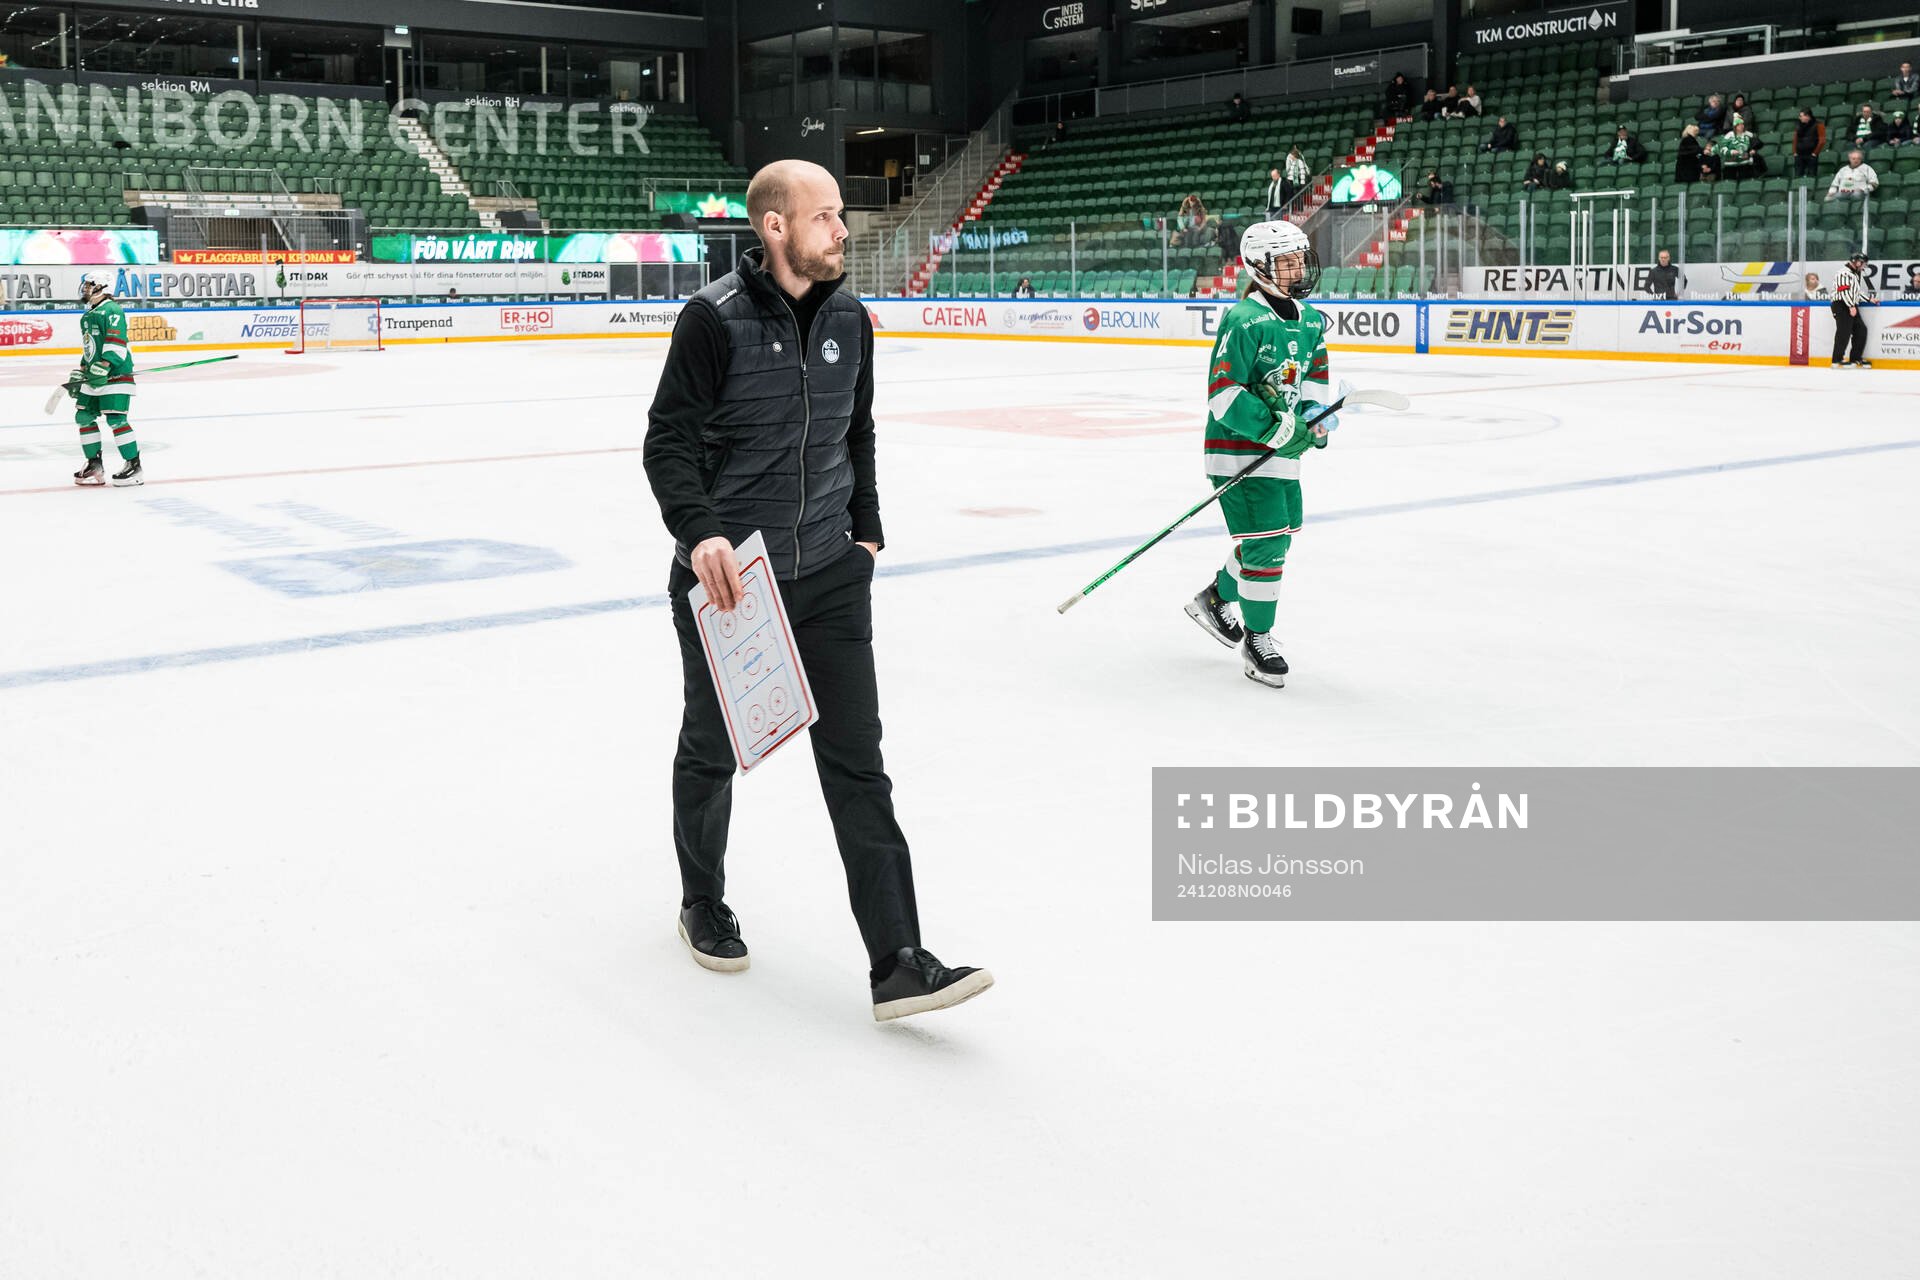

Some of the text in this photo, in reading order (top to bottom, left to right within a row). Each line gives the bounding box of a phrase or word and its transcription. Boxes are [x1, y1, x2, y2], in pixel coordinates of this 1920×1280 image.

[1061, 3, 1084, 16] INTER
[1054, 14, 1084, 28] SYSTEM
[1475, 28, 1502, 44] TKM
[141, 78, 210, 93] sektion RM
[464, 96, 520, 108] sektion RH
[608, 104, 655, 114] sektion M
[388, 98, 650, 156] CENTER
[414, 234, 537, 259] FÖR VÅRT RBK
[378, 272, 407, 281] schysst
[131, 317, 163, 329] EURO
[253, 313, 295, 327] Tommy
[385, 316, 453, 331] Tranpenad
[504, 311, 549, 323] ER-HO
[923, 307, 987, 326] CATENA
[1101, 311, 1160, 328] EUROLINK
[1638, 311, 1742, 335] AirSon
[514, 324, 539, 332] BYGG
